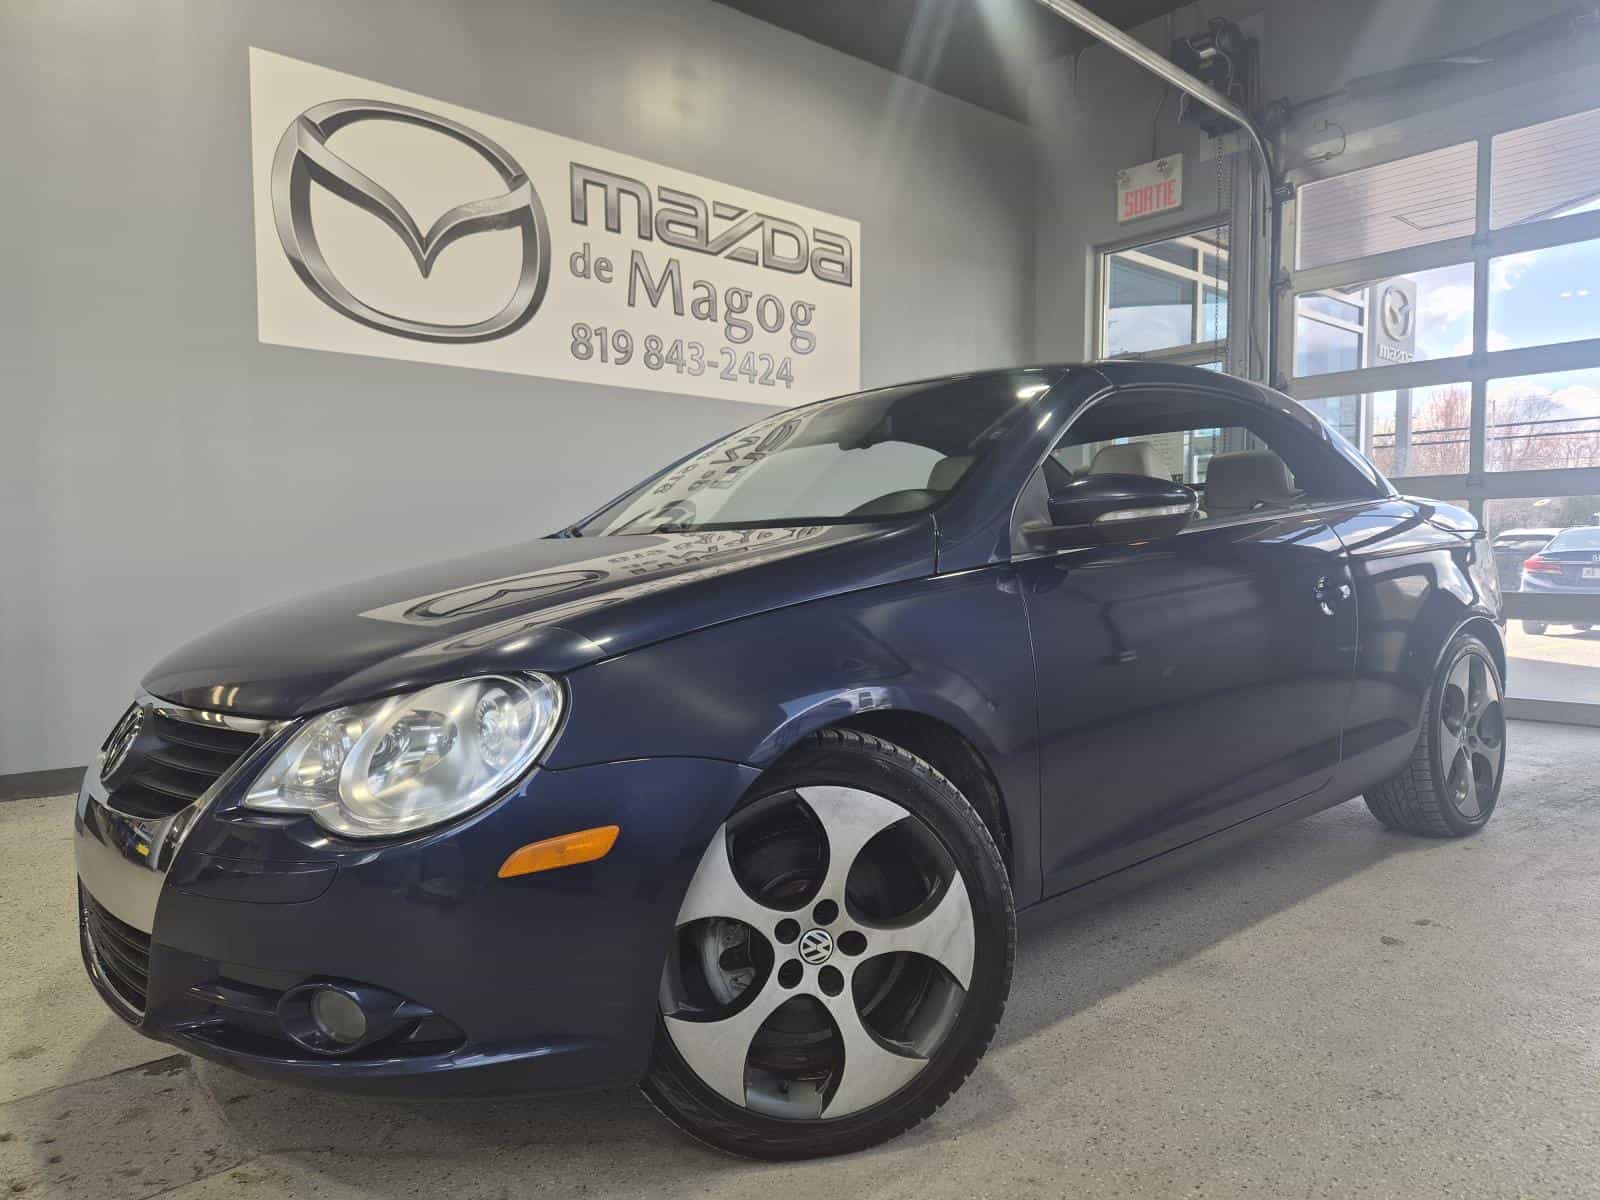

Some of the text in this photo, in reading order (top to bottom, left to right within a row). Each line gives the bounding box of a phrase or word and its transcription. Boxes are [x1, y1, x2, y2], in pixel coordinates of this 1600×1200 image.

[1123, 178, 1178, 218] SORTIE
[569, 243, 816, 355] de Magog
[570, 322, 794, 389] 819 843-2424
